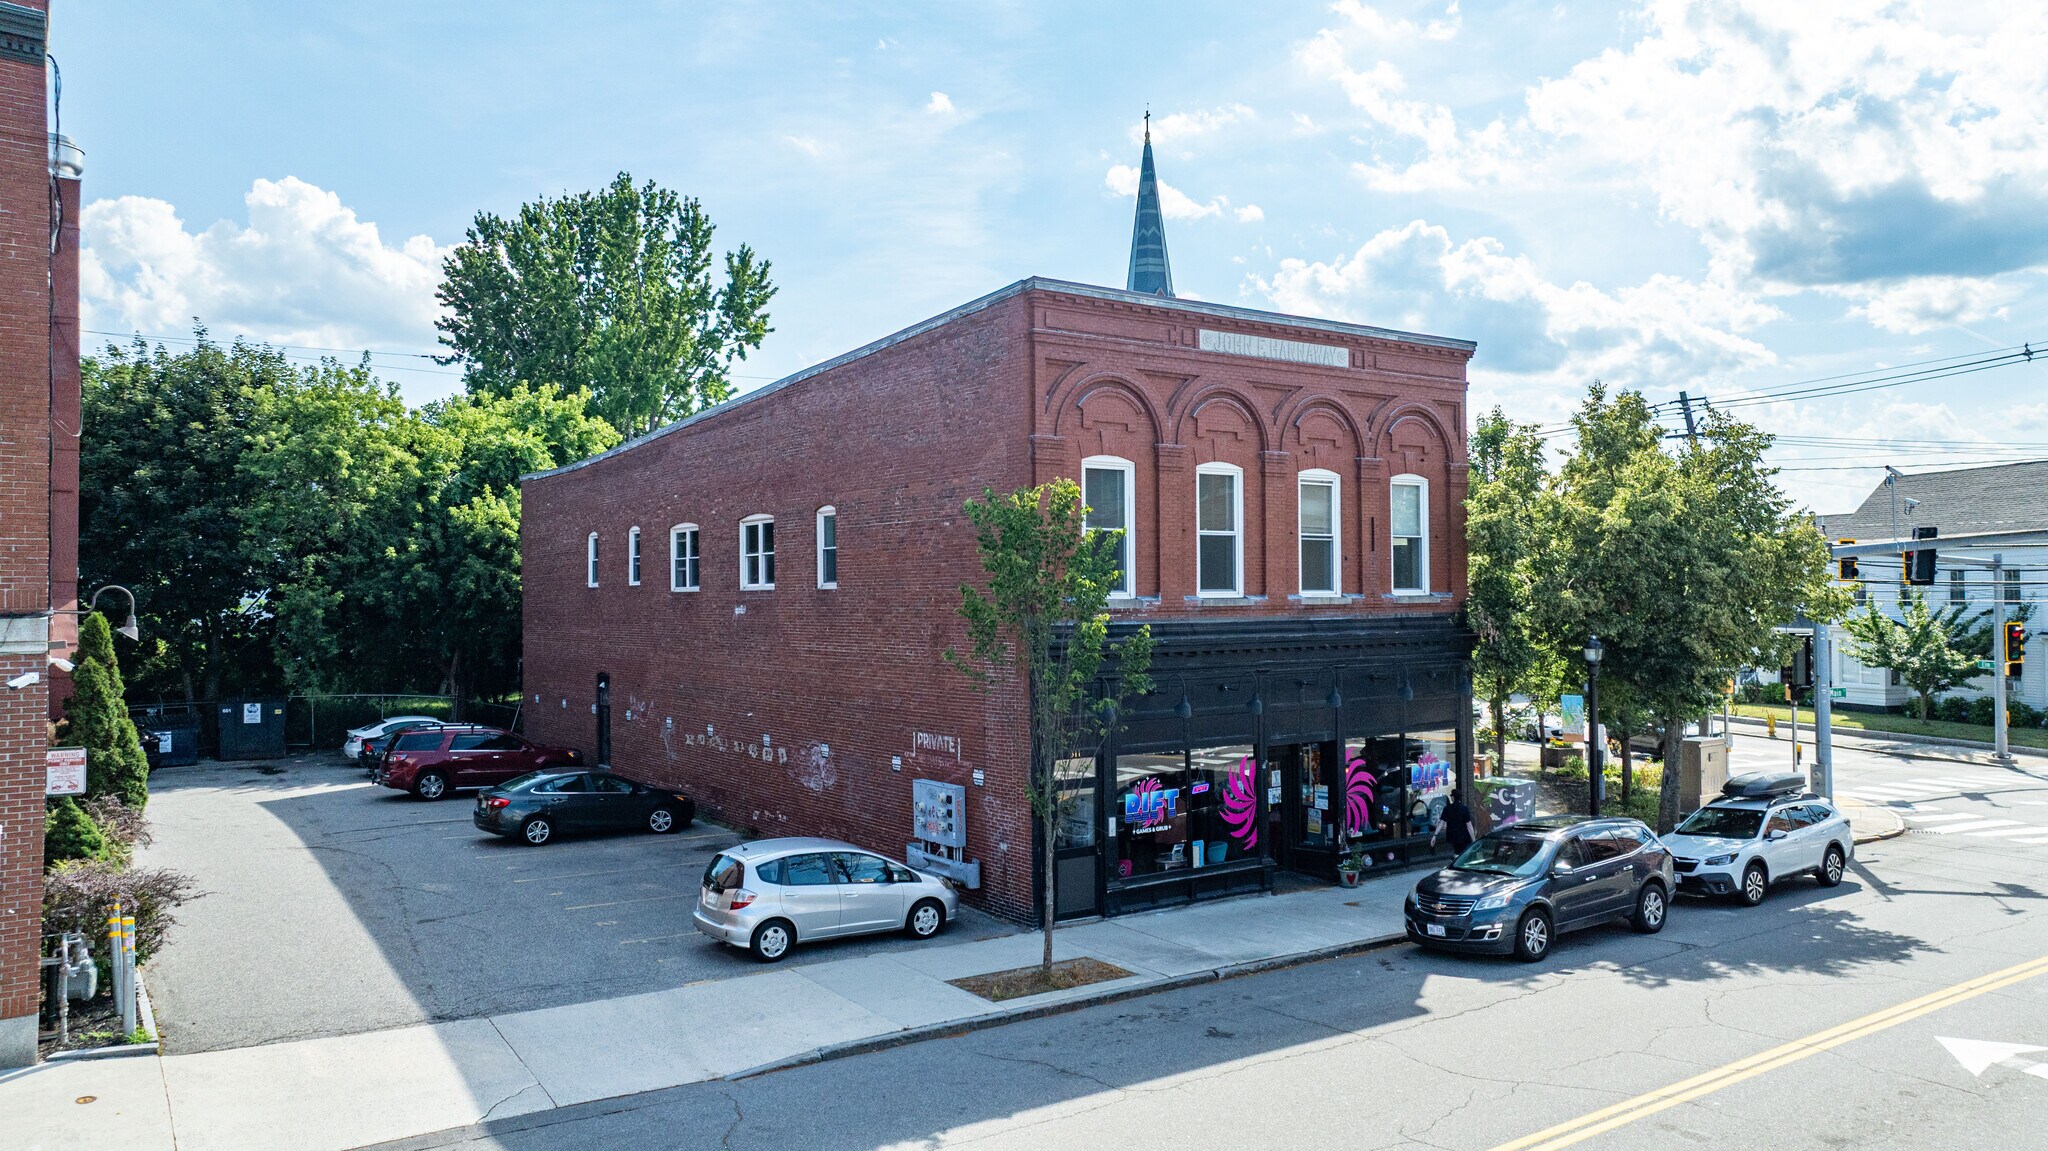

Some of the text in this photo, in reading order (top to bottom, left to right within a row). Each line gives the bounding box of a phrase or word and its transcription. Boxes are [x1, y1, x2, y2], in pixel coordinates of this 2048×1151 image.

[1213, 332, 1253, 356] JOHN
[917, 731, 955, 752] PRIVATE
[1135, 827, 1152, 835] GAMES
